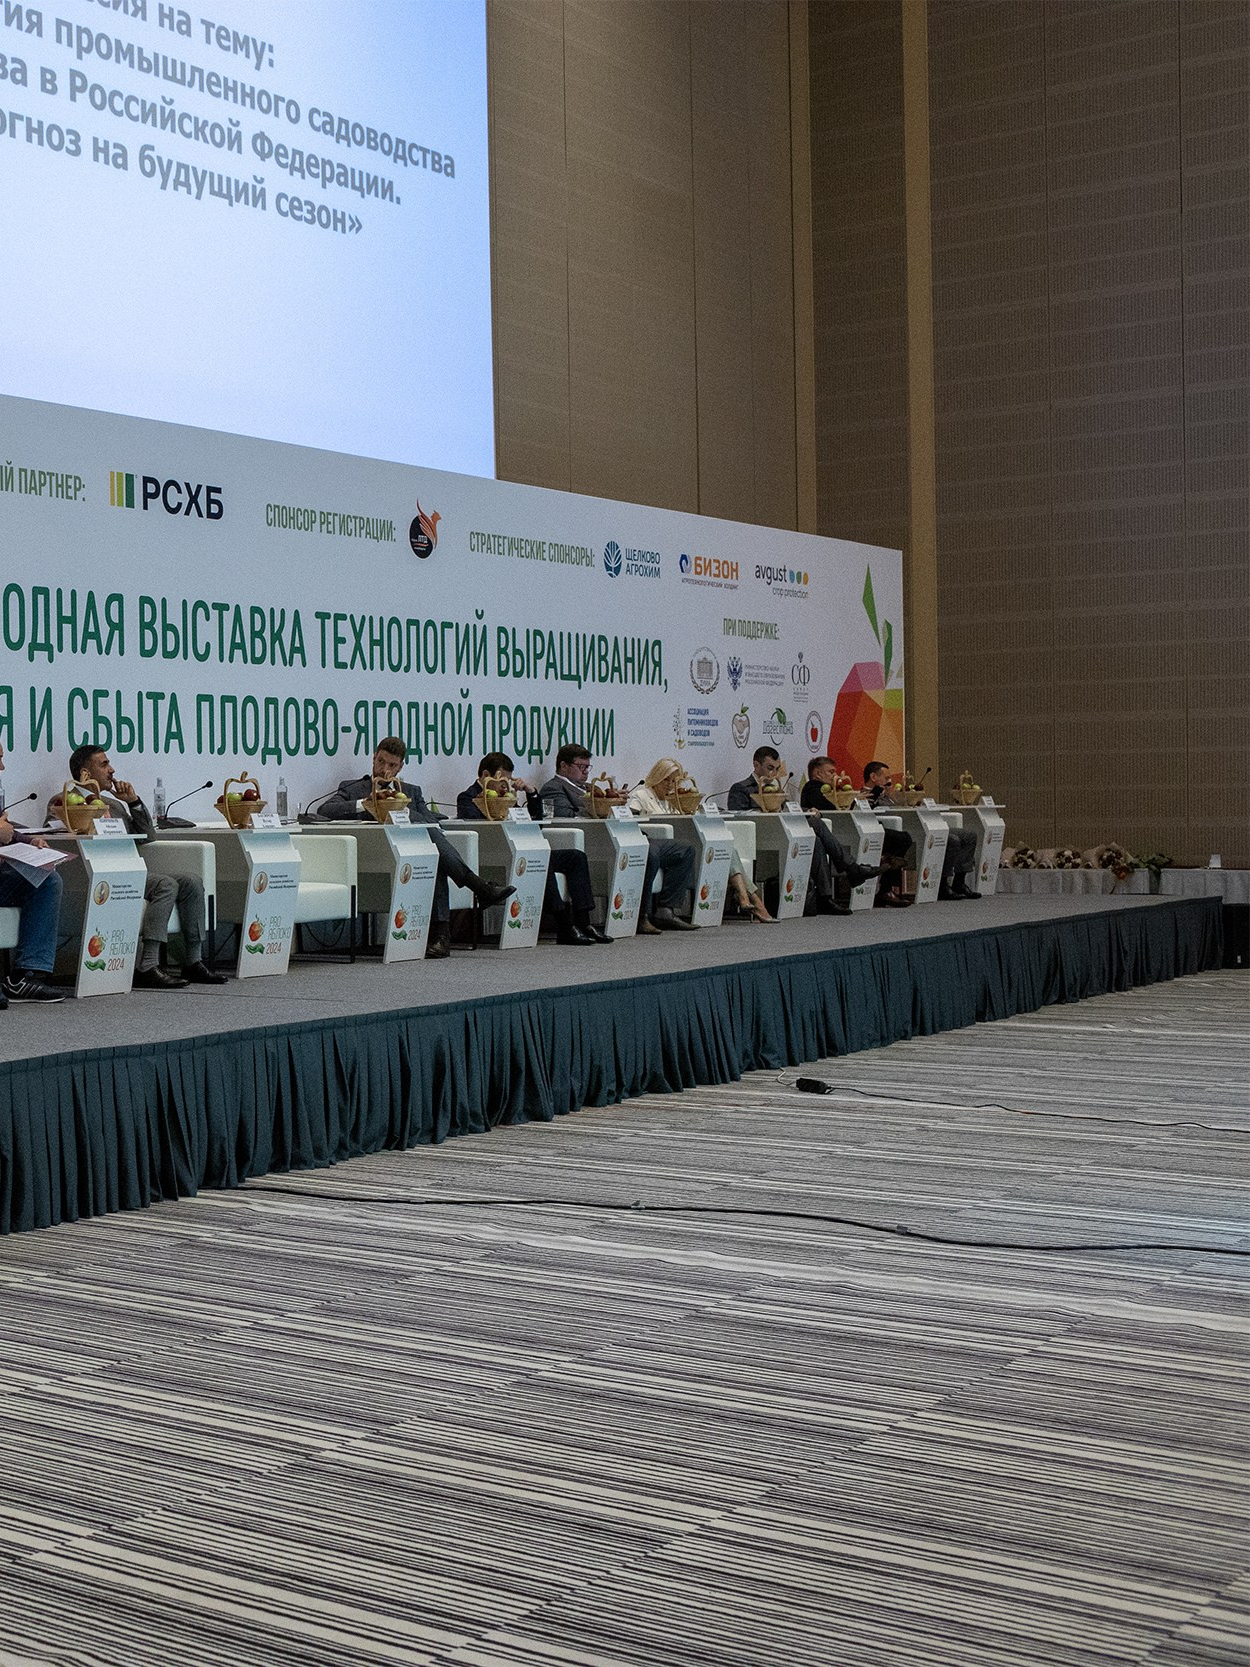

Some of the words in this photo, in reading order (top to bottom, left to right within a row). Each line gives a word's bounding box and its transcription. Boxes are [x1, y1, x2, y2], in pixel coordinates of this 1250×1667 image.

[158, 3, 191, 37] на
[201, 18, 274, 71] тему:
[55, 18, 300, 124] промышленного
[308, 107, 455, 178] садоводства
[40, 66, 58, 95] в
[69, 68, 243, 155] Российской
[251, 130, 400, 205] Федерации.
[92, 136, 128, 171] на
[138, 144, 267, 211] будущий
[275, 191, 363, 235] сезон»
[18, 467, 86, 502] ПАРТНЕР:
[142, 476, 224, 520] РСХБ
[266, 503, 317, 533] СПОНСОР
[319, 508, 397, 542] РЕГИСТРАЦИИ:
[469, 531, 546, 561] СТРАТЕГИЧЕСКИЕ
[548, 543, 595, 568] СПОНСОРЫ:
[625, 547, 660, 564] ЩЕЛКОВО
[625, 562, 661, 579] АГРОХИМ
[694, 556, 739, 581] БИЗОН
[755, 564, 787, 585] avgust
[138, 595, 307, 668] ВЫСТАВКА
[314, 608, 488, 677] ТЕХНОЛОГИЙ
[497, 627, 668, 694] ВЫРАЩИВАНИЯ,
[723, 618, 736, 636] ПРИ
[738, 619, 780, 640] ПОДДЕРЖКЕ:
[30, 686, 53, 753] И
[67, 687, 185, 755] СБЫТА
[196, 688, 473, 766] ПЛОДОВО-ЯГОДНОЙ
[483, 704, 615, 765] ПРОДУКЦИИ
[108, 958, 125, 971] 2024
[110, 942, 135, 955] ЯБЛОКО
[266, 942, 282, 954] 2024
